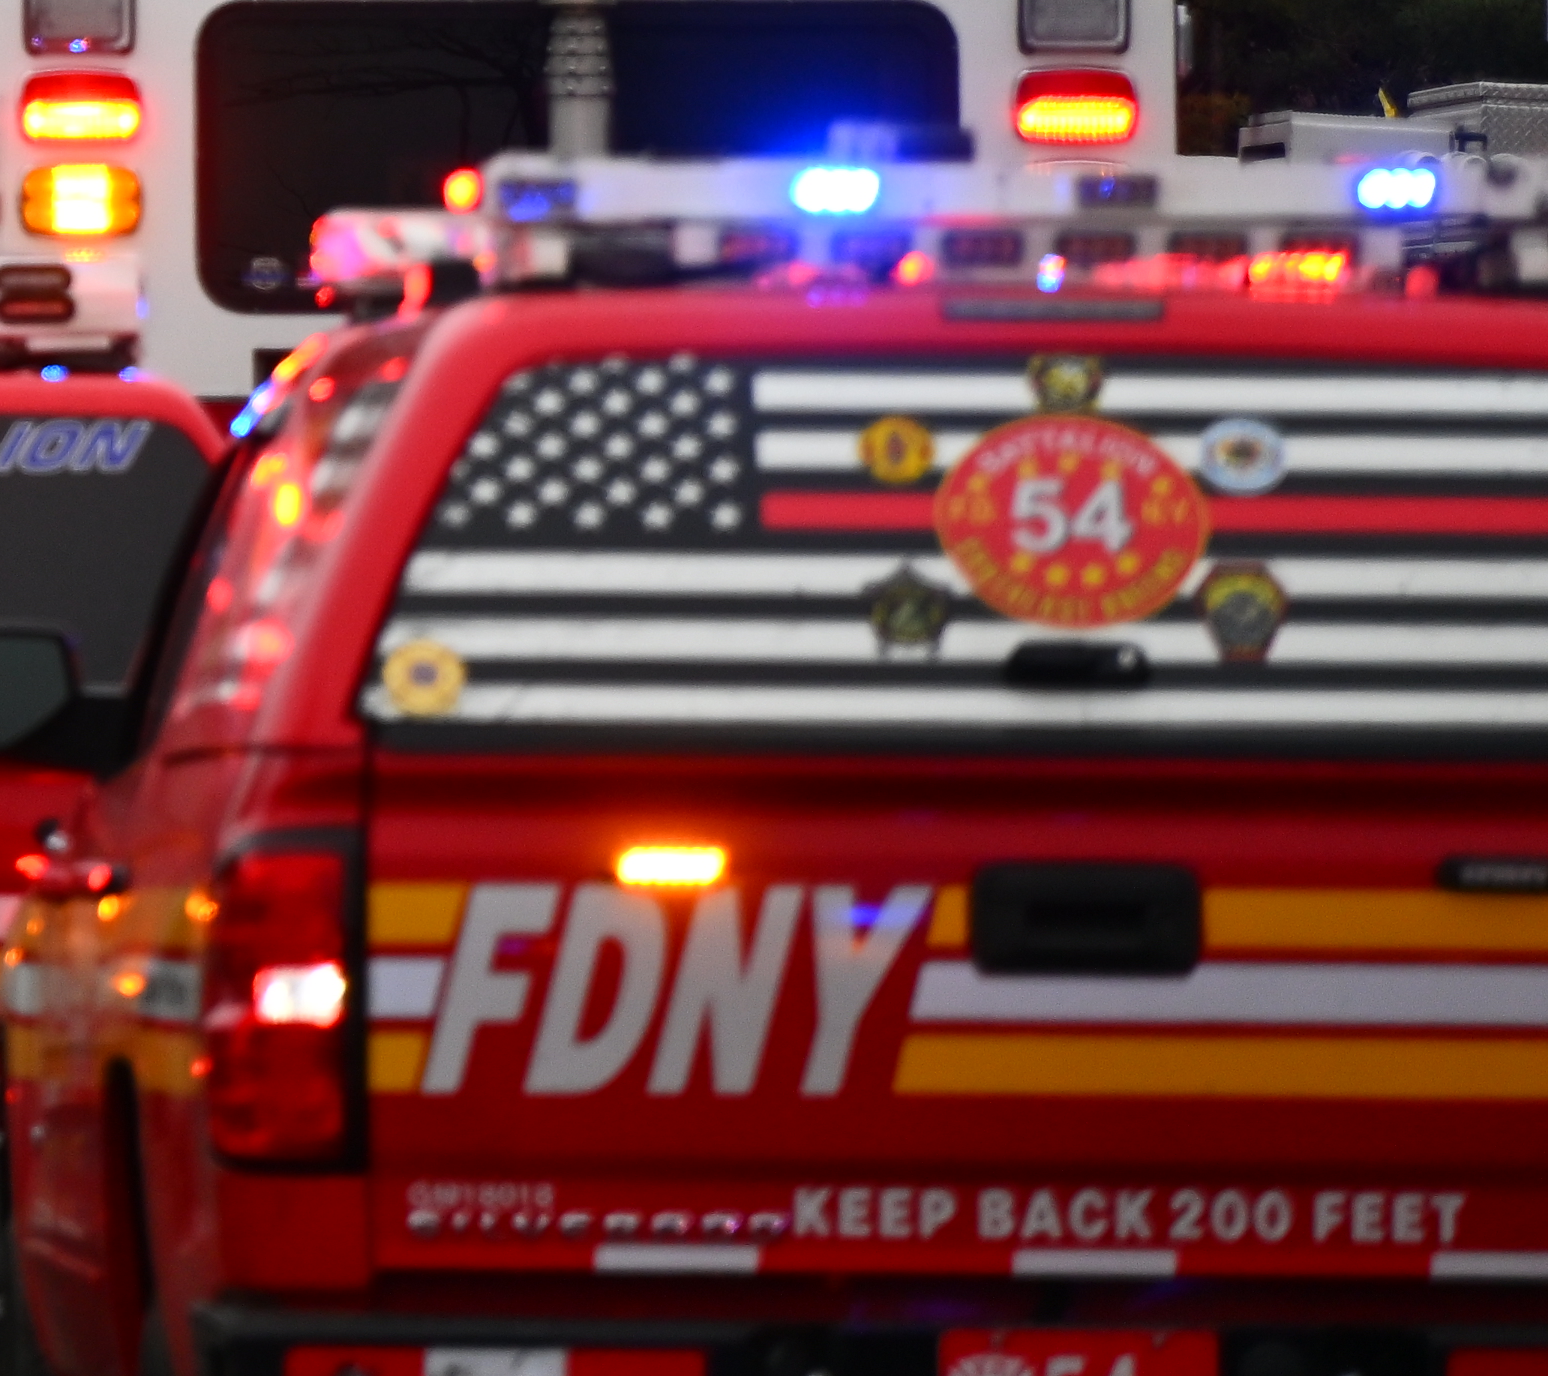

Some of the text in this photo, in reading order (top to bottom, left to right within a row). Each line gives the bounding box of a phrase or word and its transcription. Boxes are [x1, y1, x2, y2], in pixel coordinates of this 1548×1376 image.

[1009, 475, 1134, 554] 54
[418, 880, 934, 1099] FDNY
[791, 1185, 1467, 1246] KEEP BACK 200 FEET
